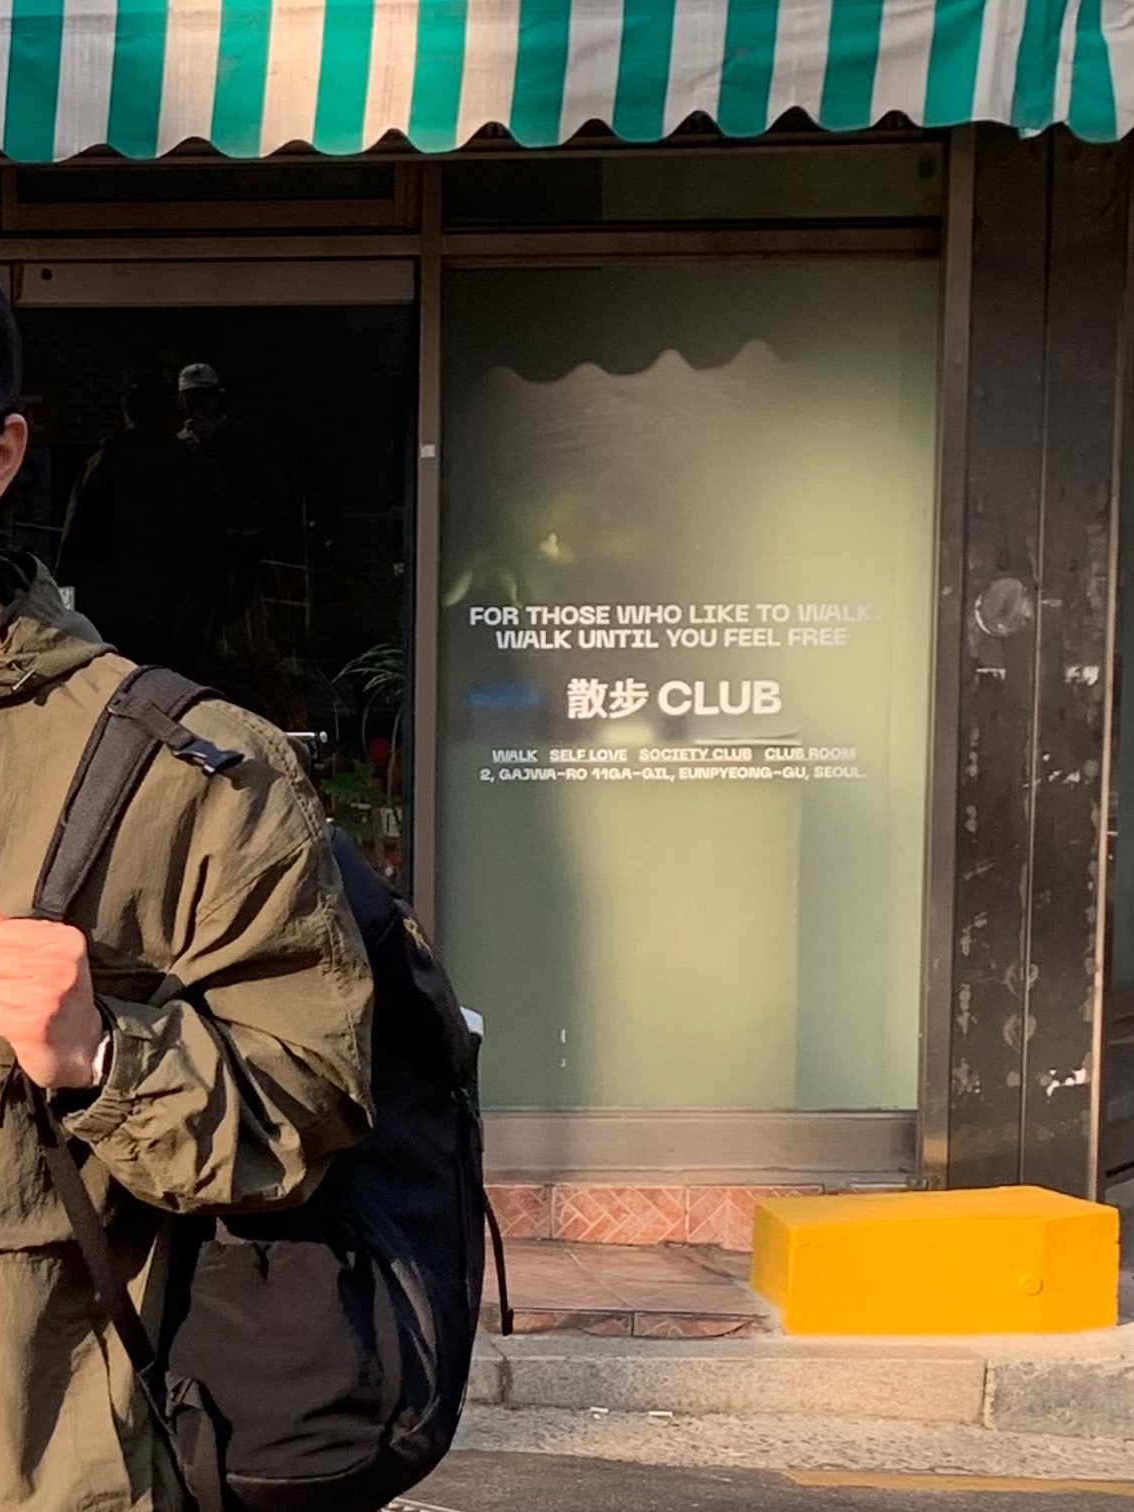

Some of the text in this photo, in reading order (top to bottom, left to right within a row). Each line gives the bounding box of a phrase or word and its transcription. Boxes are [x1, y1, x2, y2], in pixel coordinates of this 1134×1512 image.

[469, 604, 520, 626] FOR
[525, 604, 611, 626] THOSE
[615, 604, 683, 626] WHO
[689, 604, 750, 626] LIKE
[756, 604, 791, 626] TO
[495, 627, 848, 649] WALK UNTIL YOU FEEL FREE
[657, 680, 782, 716] CLUB
[491, 748, 857, 763] WALK SELF LOVE SOCIETY CLUB CLUB ROOM
[479, 766, 496, 783] 2,
[498, 766, 589, 783] GAJWA-RO
[678, 766, 810, 783] EUNPYEONG-GU,
